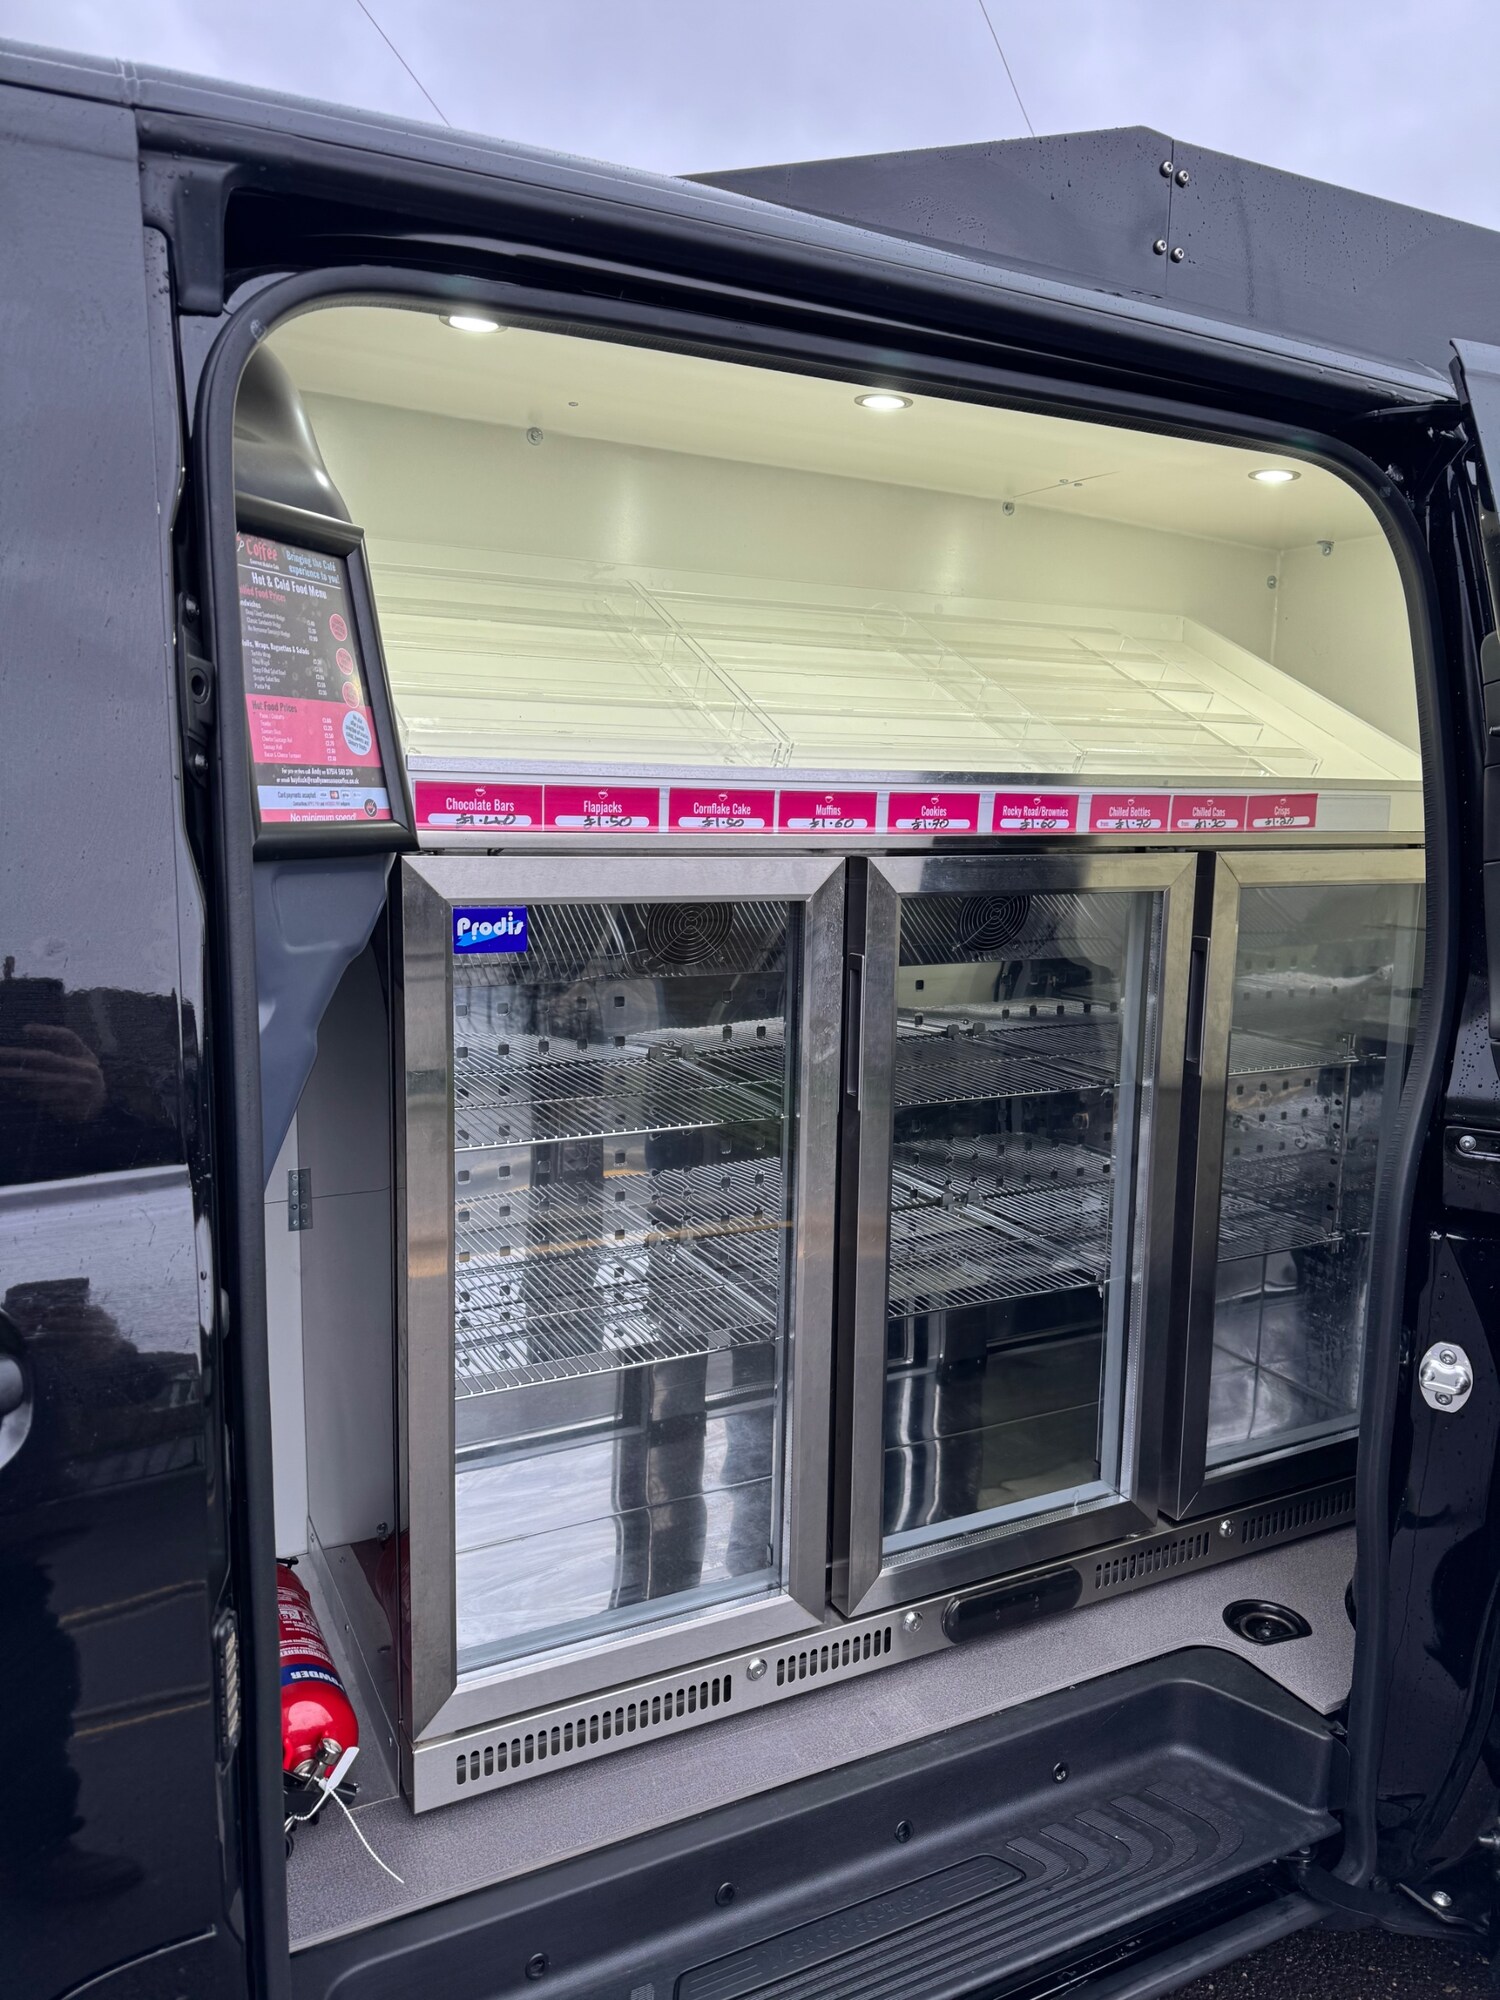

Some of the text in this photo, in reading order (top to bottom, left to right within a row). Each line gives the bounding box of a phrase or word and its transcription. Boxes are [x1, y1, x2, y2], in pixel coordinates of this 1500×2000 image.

[246, 538, 278, 561] Coffee
[286, 550, 312, 568] Bringing
[312, 556, 322, 568] the
[289, 564, 340, 584] experience to you!
[252, 572, 327, 599] Hot & Cold Food Menu
[255, 588, 269, 600] Food
[269, 590, 286, 602] Prices
[254, 640, 270, 650] Wraps,
[270, 643, 292, 652] Baguettes
[296, 646, 310, 655] Salads
[252, 700, 297, 713] Hot Food Prices
[446, 798, 514, 812] Chocolate Bars
[584, 800, 622, 815] Flapjacks
[694, 802, 751, 815] Cornflake Cake
[816, 804, 841, 816] Muffins
[921, 805, 947, 817] Cookies
[1002, 805, 1069, 818] Rocky Road/Brownies
[1108, 806, 1151, 817] Chilled Bottles
[1192, 806, 1226, 817] Chilled Cans
[1274, 806, 1290, 817] Crisps
[290, 813, 300, 822] No
[302, 813, 334, 821] minimum
[584, 816, 632, 829] £1.50
[701, 816, 744, 828] £1.50
[809, 818, 854, 829] £1.60
[912, 818, 949, 830] £1.70
[1020, 818, 1056, 830] £1.60
[1115, 819, 1151, 829] £1.70
[457, 911, 524, 940] Prodis
[761, 1886, 931, 1969] Mercedes-Benz
